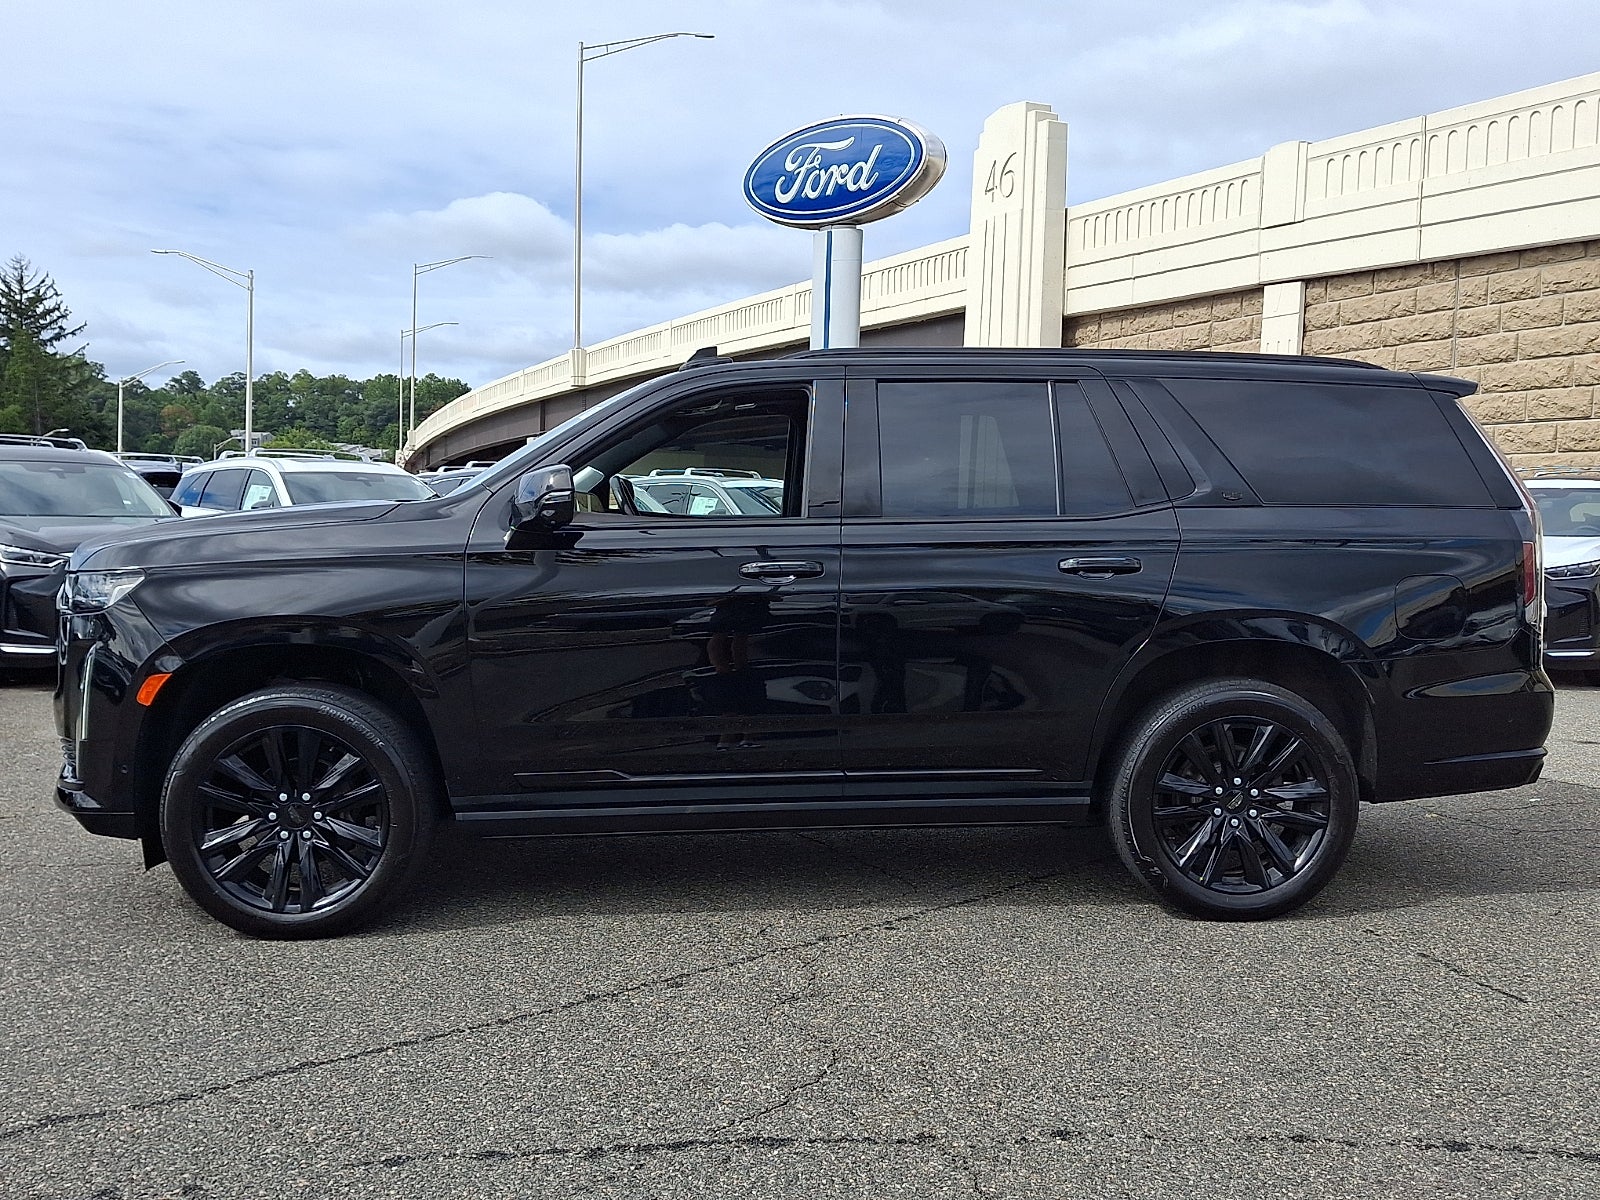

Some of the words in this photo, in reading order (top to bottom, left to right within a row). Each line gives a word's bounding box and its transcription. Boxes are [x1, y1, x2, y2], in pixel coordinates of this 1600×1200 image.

[775, 137, 883, 204] Ford
[984, 152, 1017, 202] 46
[317, 705, 385, 749] BRIDGESTONE
